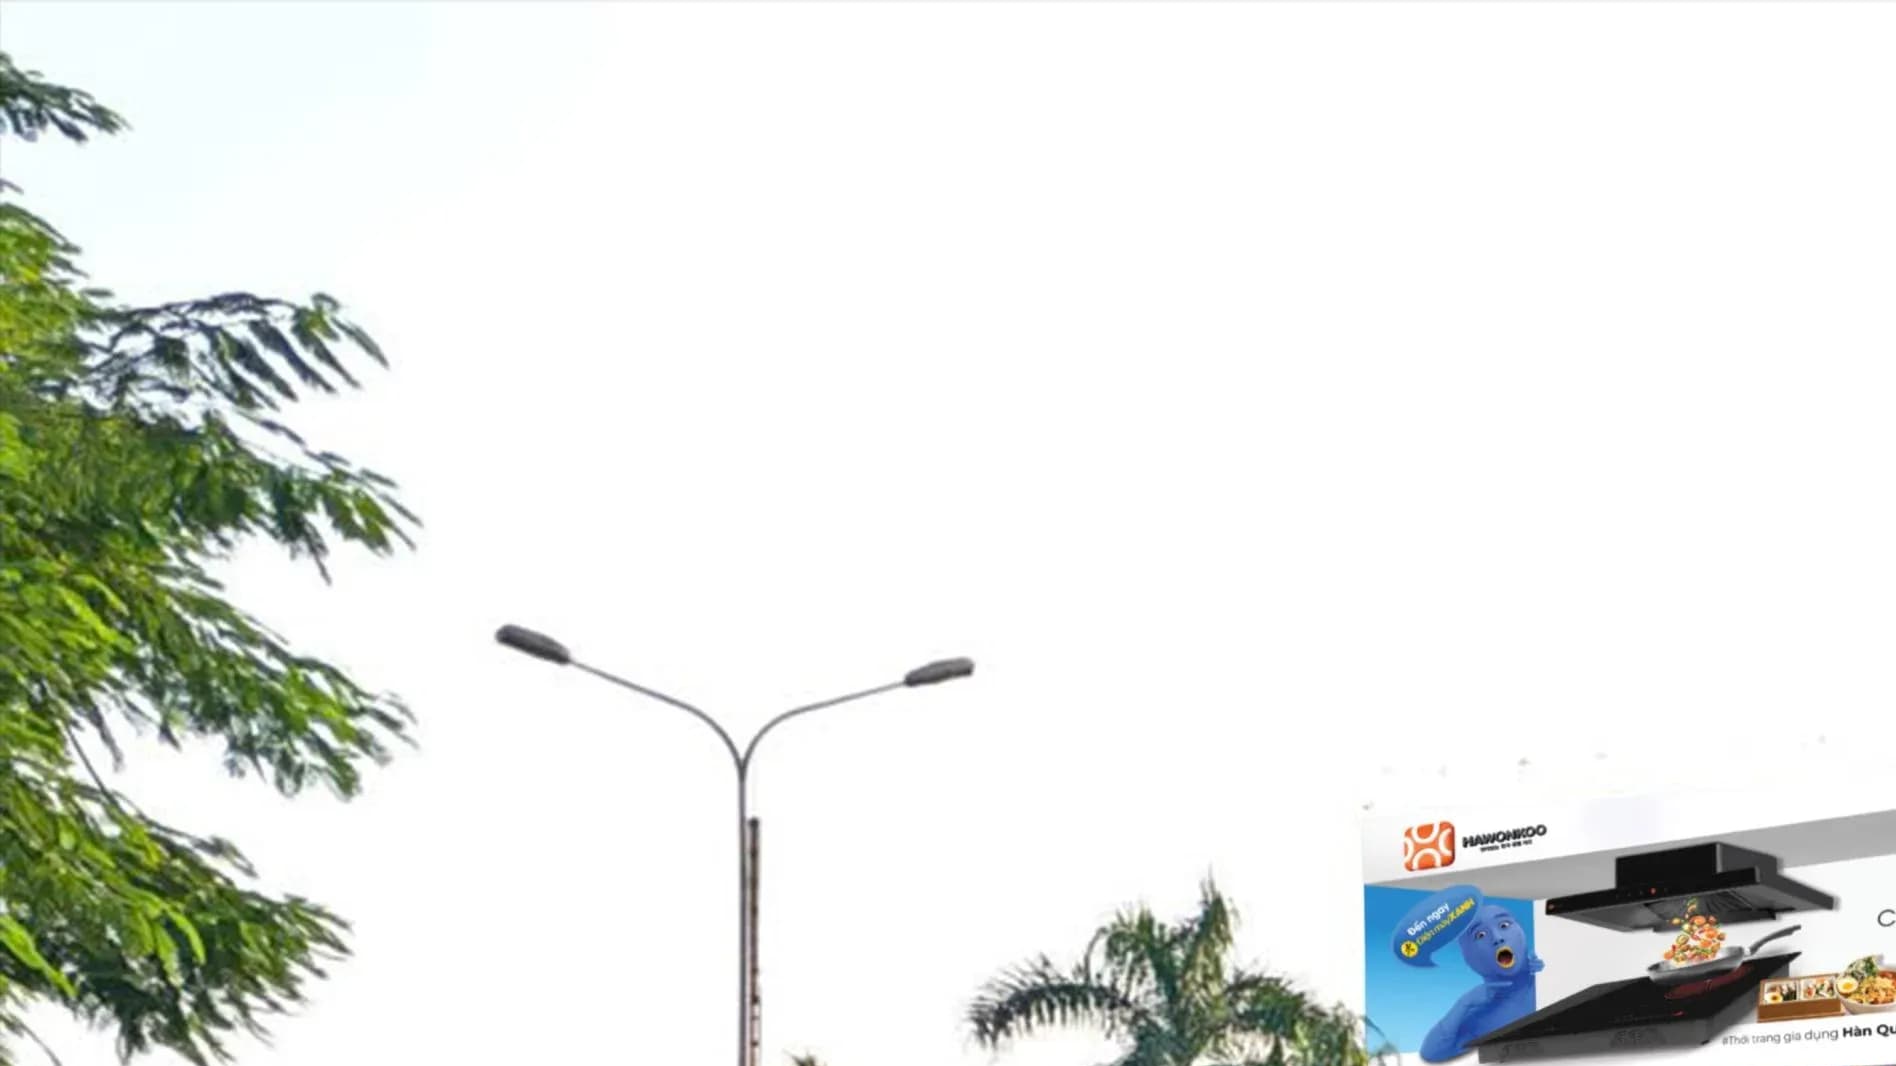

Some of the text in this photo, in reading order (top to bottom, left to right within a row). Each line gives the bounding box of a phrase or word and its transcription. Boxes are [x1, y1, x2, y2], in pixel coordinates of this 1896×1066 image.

[1462, 824, 1548, 848] HAWONKOO
[1426, 902, 1450, 922] ngay
[1752, 1032, 1782, 1045] trang
[1784, 1030, 1801, 1044] gia
[1804, 1028, 1840, 1043] dụng
[1842, 1026, 1873, 1039] Hàn
